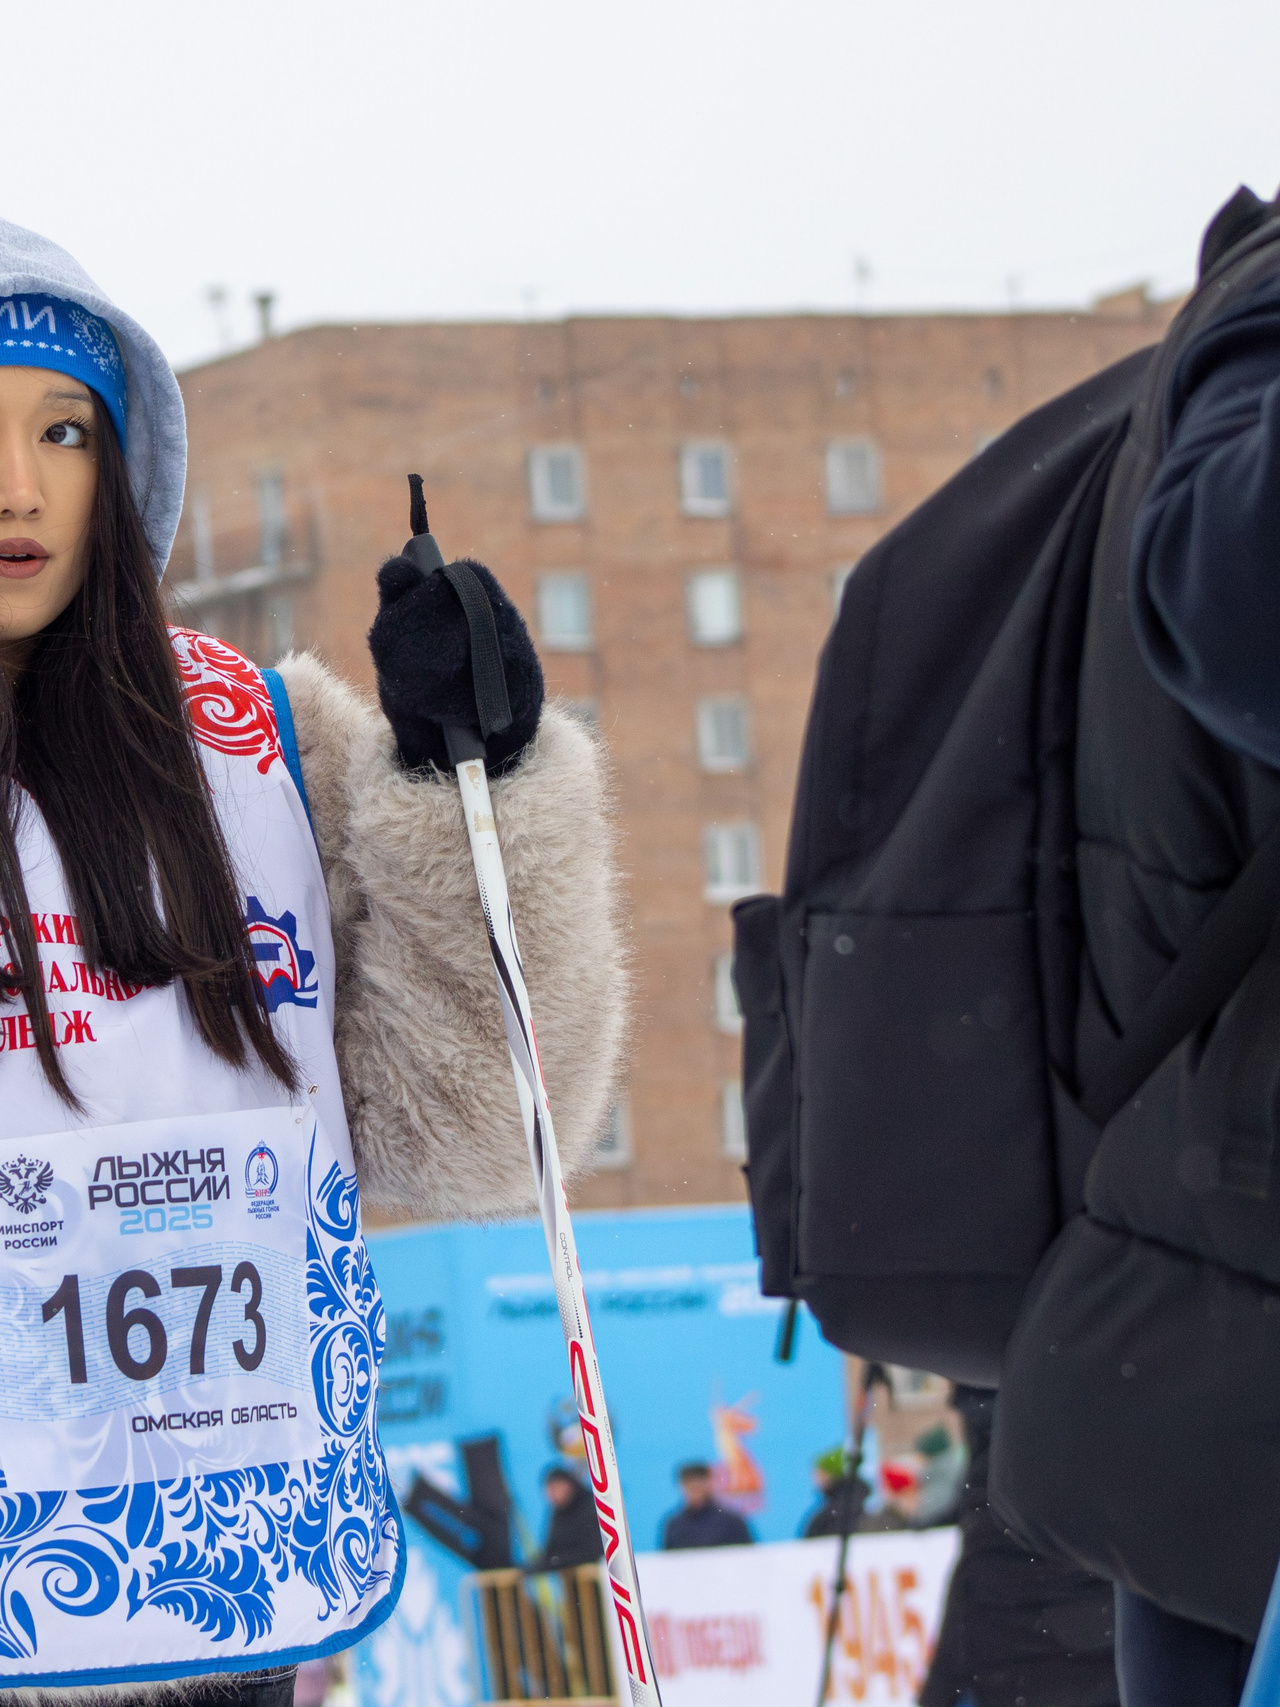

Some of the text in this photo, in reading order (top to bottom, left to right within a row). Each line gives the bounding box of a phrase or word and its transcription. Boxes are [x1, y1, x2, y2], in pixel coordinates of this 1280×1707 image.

[92, 1147, 226, 1182] ЛЫЖНЯ
[87, 1175, 231, 1210] РОССИИ
[120, 1204, 214, 1235] 2025
[4, 1236, 58, 1250] РОССИИ
[559, 1232, 573, 1282] CONTROL
[41, 1261, 267, 1384] 1673
[132, 1402, 298, 1433] ОМСКАЯ ОБЛАСТЬ
